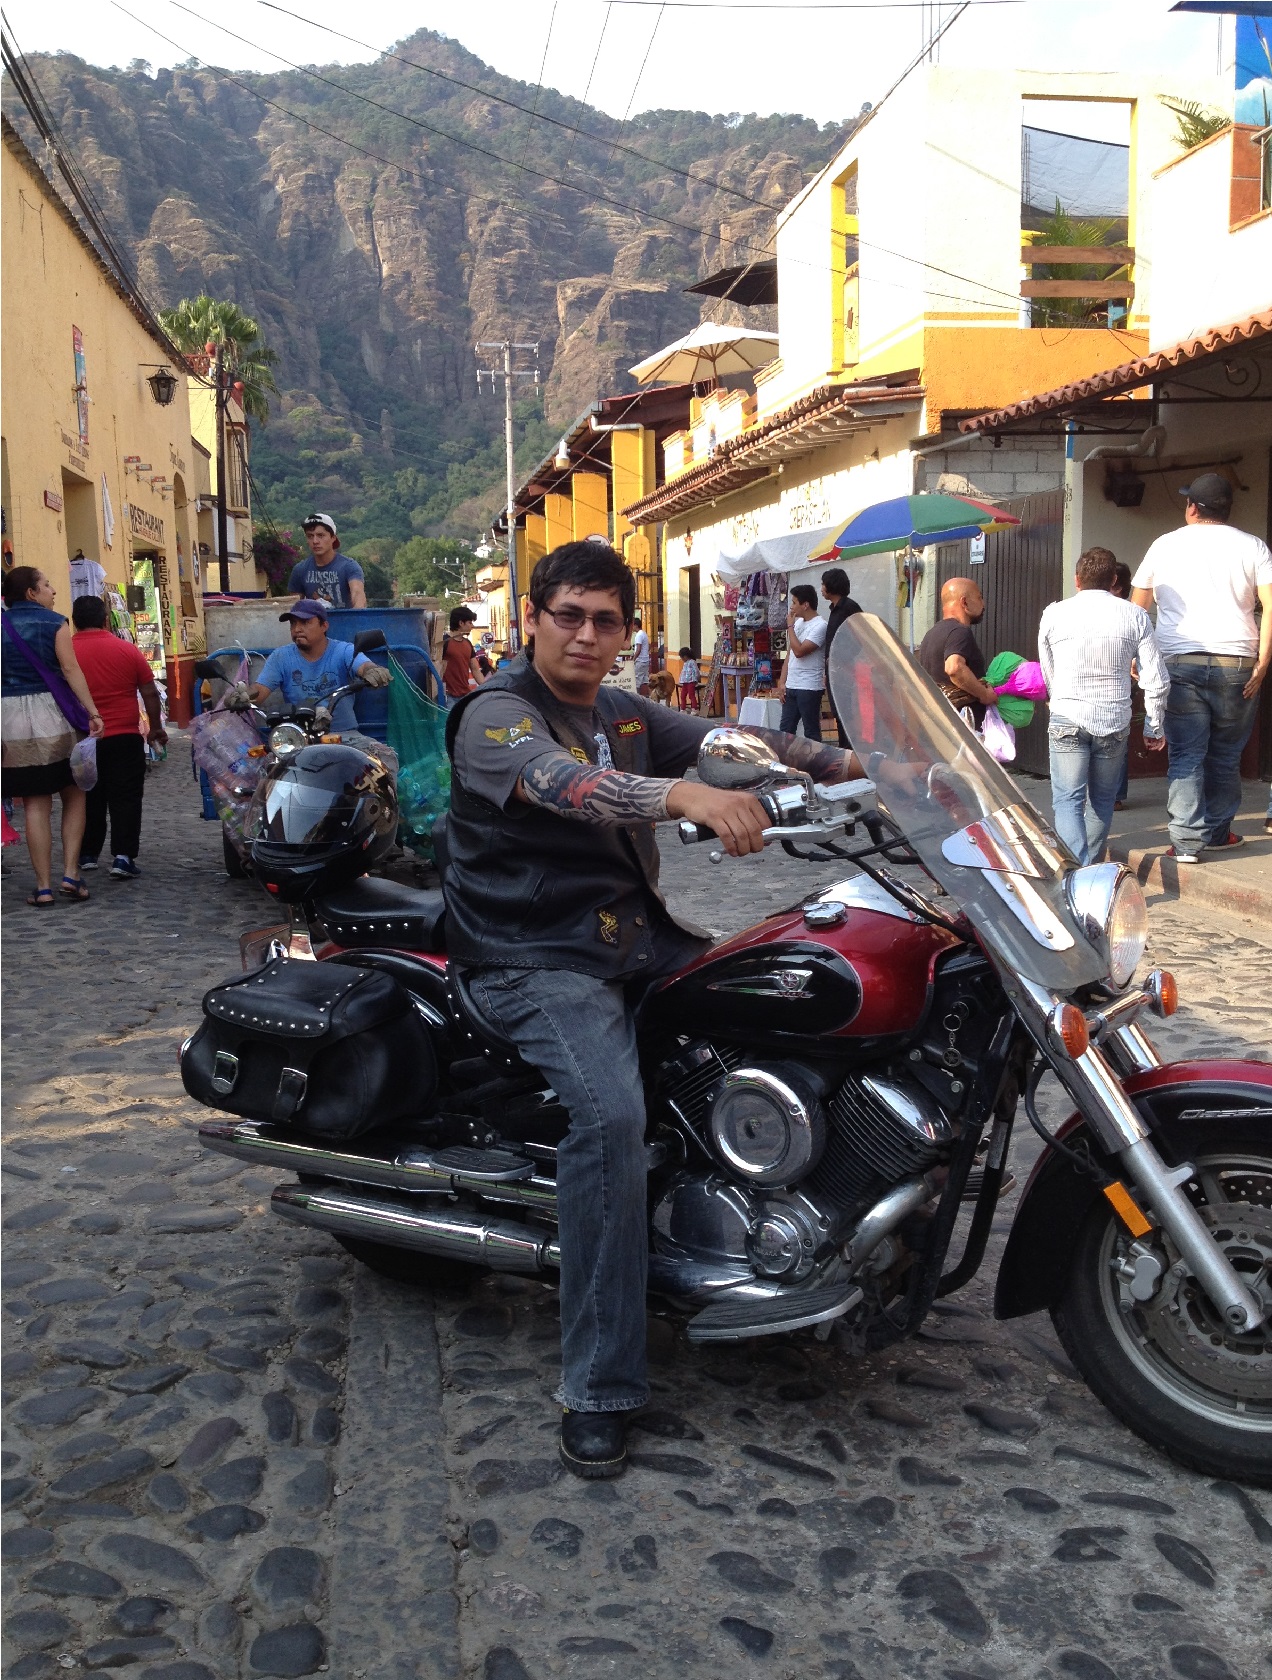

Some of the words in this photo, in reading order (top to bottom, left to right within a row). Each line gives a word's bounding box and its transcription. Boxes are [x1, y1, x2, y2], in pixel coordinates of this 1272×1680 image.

[129, 503, 164, 544] RESTAURANT
[159, 556, 171, 645] RESTAURANT
[618, 721, 642, 734] JAMES
